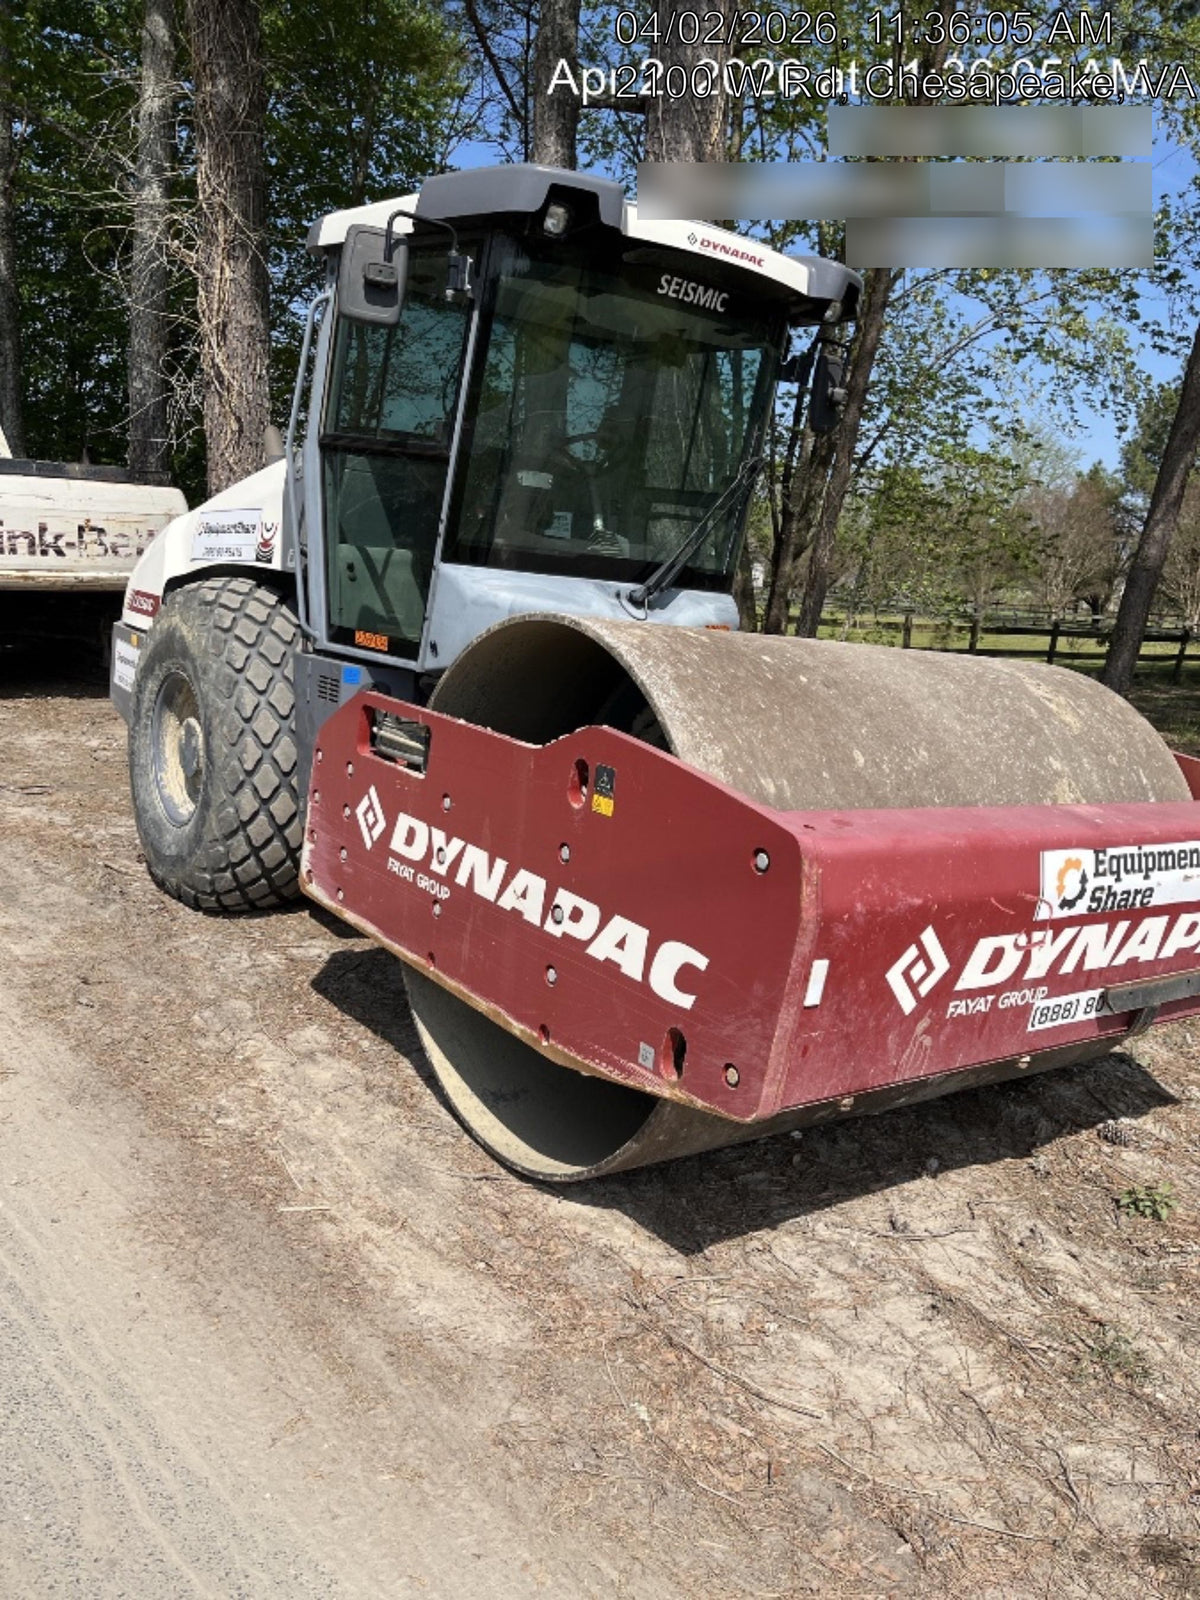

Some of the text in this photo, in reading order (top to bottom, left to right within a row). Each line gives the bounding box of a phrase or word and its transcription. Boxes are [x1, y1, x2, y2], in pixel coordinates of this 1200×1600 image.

[700, 237, 765, 268] DYNAPAC
[657, 273, 729, 313] SEISMIC
[387, 855, 451, 900] FAYAT GROUP
[389, 812, 710, 1010] DYNAPAC
[1086, 885, 1154, 913] Share
[953, 911, 1200, 991] DYNAP
[945, 986, 1048, 1019] FAYAT GROUP
[1030, 998, 1080, 1029] (888)
